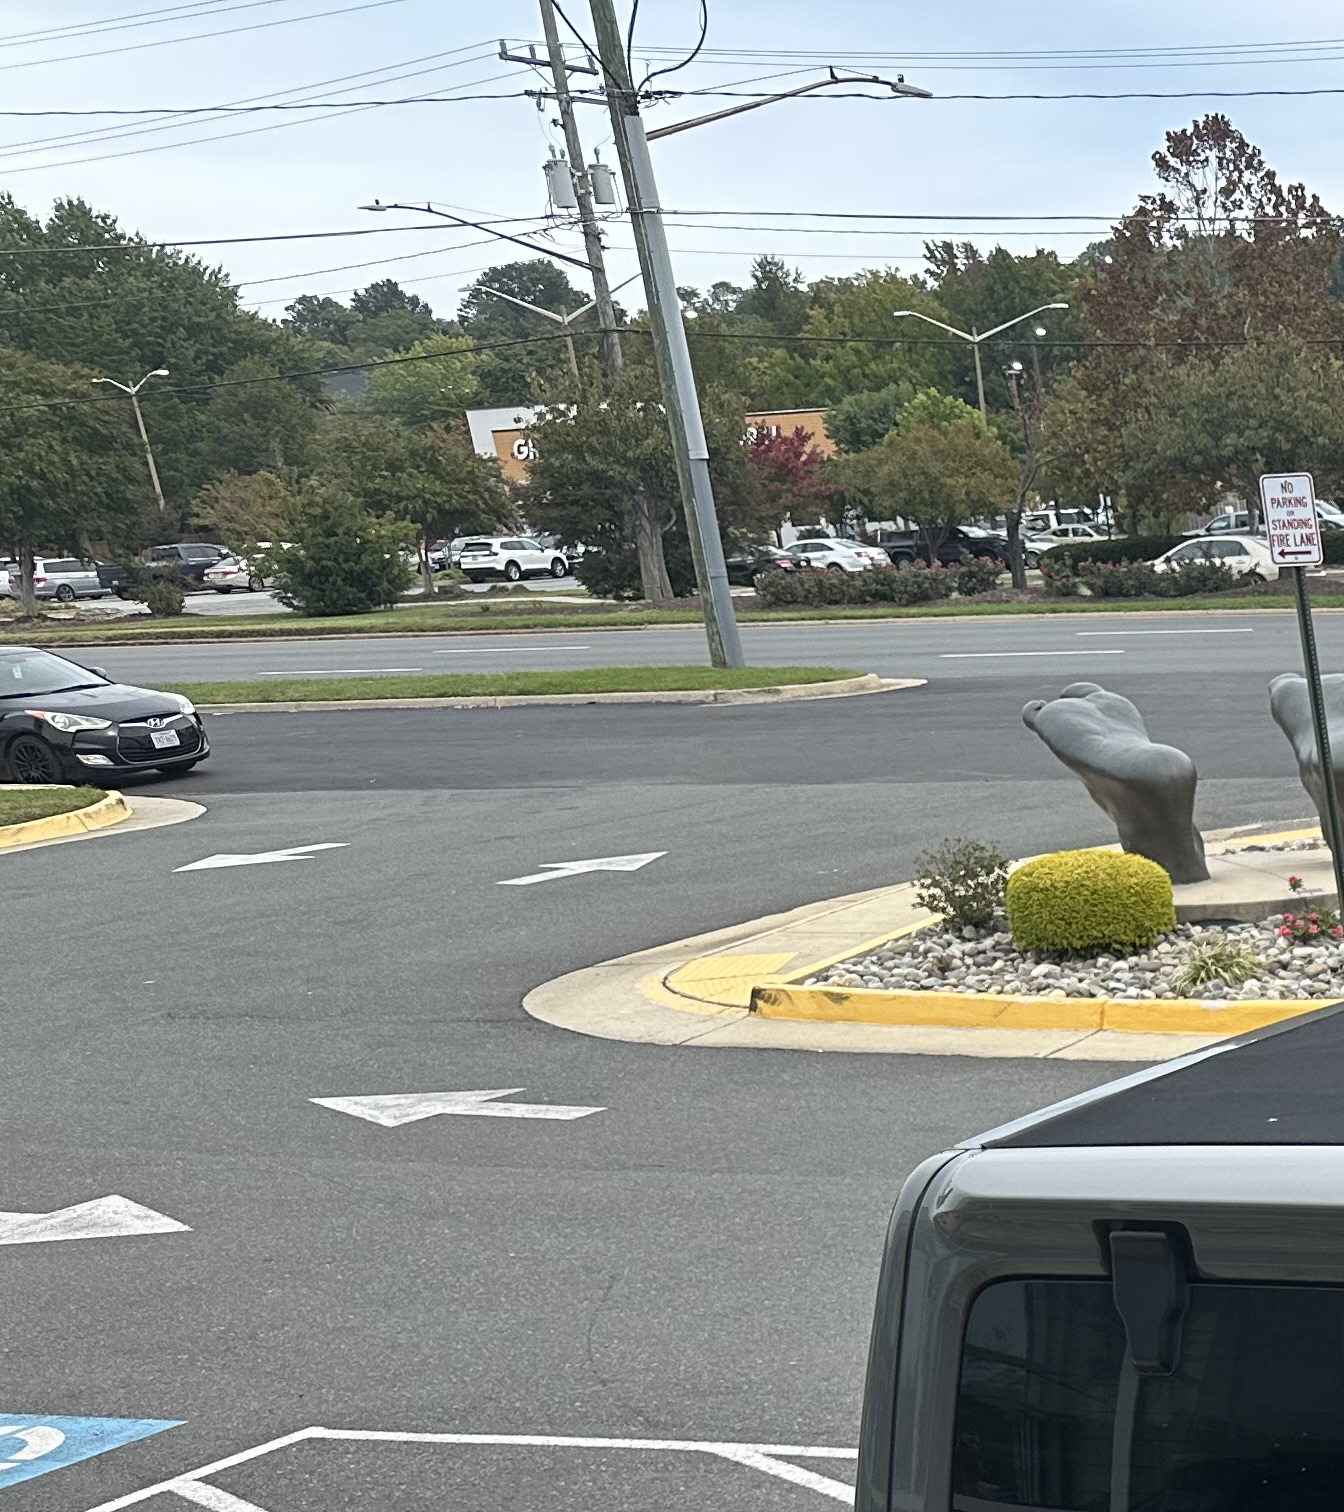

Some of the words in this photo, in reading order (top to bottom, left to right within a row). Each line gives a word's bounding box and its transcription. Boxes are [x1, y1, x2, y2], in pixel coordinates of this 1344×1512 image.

[1280, 480, 1294, 494] NO
[1270, 496, 1308, 509] PARKING
[1271, 518, 1313, 530] STANDING
[1271, 533, 1291, 548] FIRE
[1293, 532, 1317, 547] LANE
